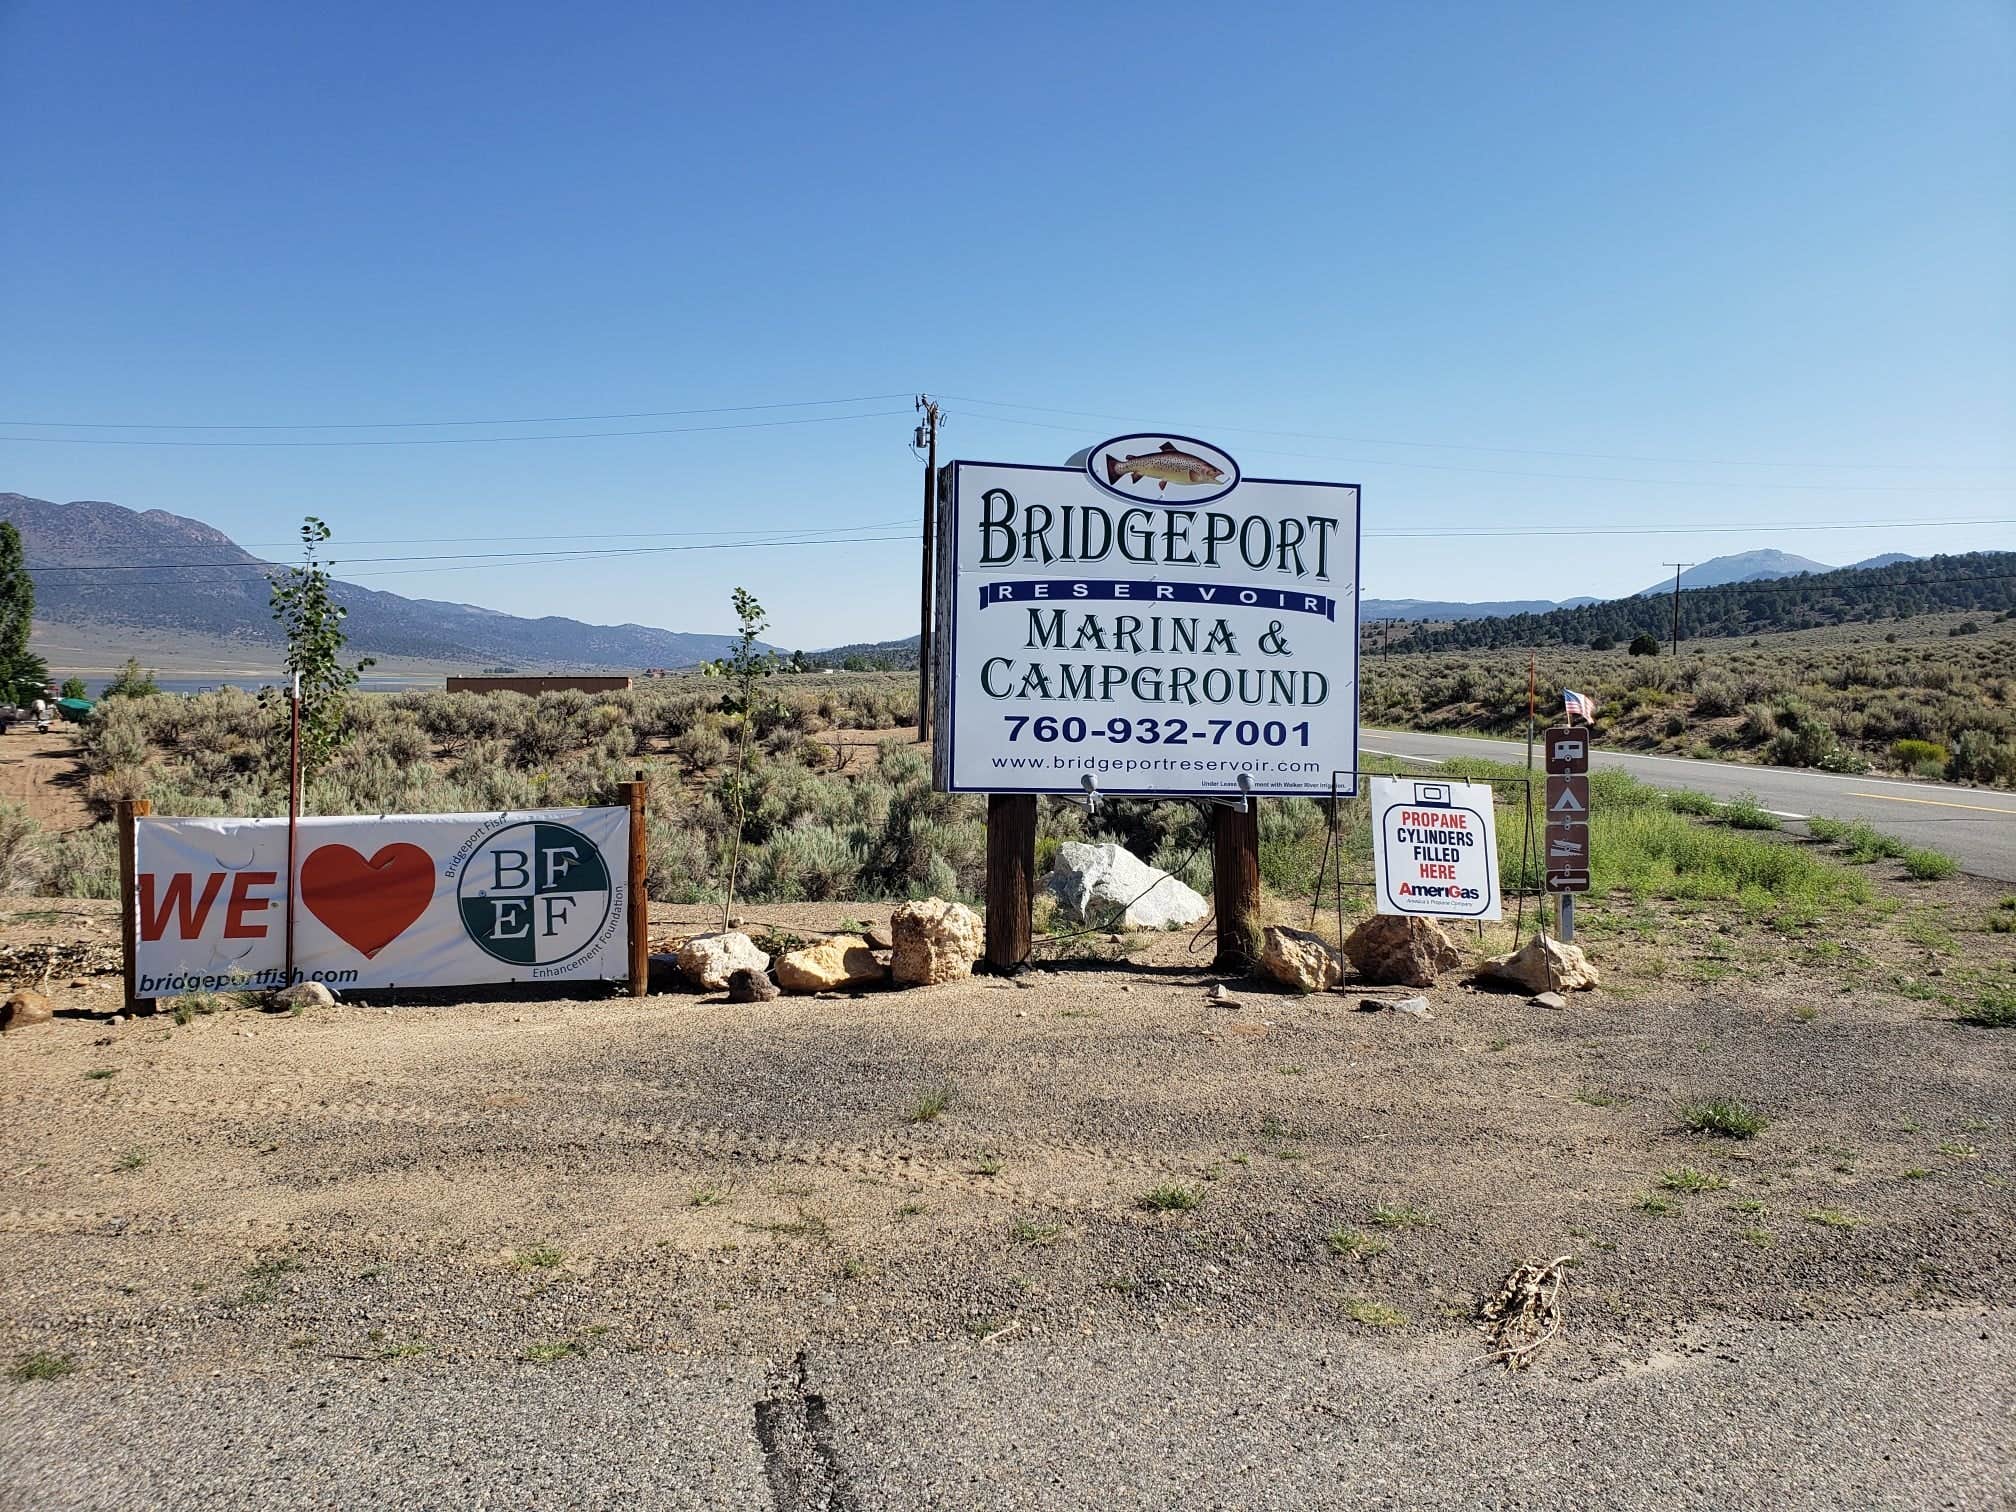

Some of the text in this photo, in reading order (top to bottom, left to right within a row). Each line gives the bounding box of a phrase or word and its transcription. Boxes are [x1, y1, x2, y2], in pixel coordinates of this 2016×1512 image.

[979, 487, 1339, 582] BRIDGEPORT
[998, 582, 1319, 611] RESERVOIR
[1024, 607, 1294, 657] MARINA &
[980, 656, 1330, 707] CAMPGROUND
[1003, 715, 1311, 747] 760-932-7001
[991, 755, 1320, 773] www.bridgeportreservoir.com
[1401, 811, 1467, 829] PROPANE
[444, 815, 508, 878] Bridgeport Fish
[1397, 827, 1474, 847] CYLINDERS
[1413, 846, 1460, 863] FILLED
[1419, 863, 1457, 880] HERE
[1398, 882, 1480, 900] AmeriGas
[138, 872, 278, 941] WE
[532, 886, 624, 978] Enhancement Foundation
